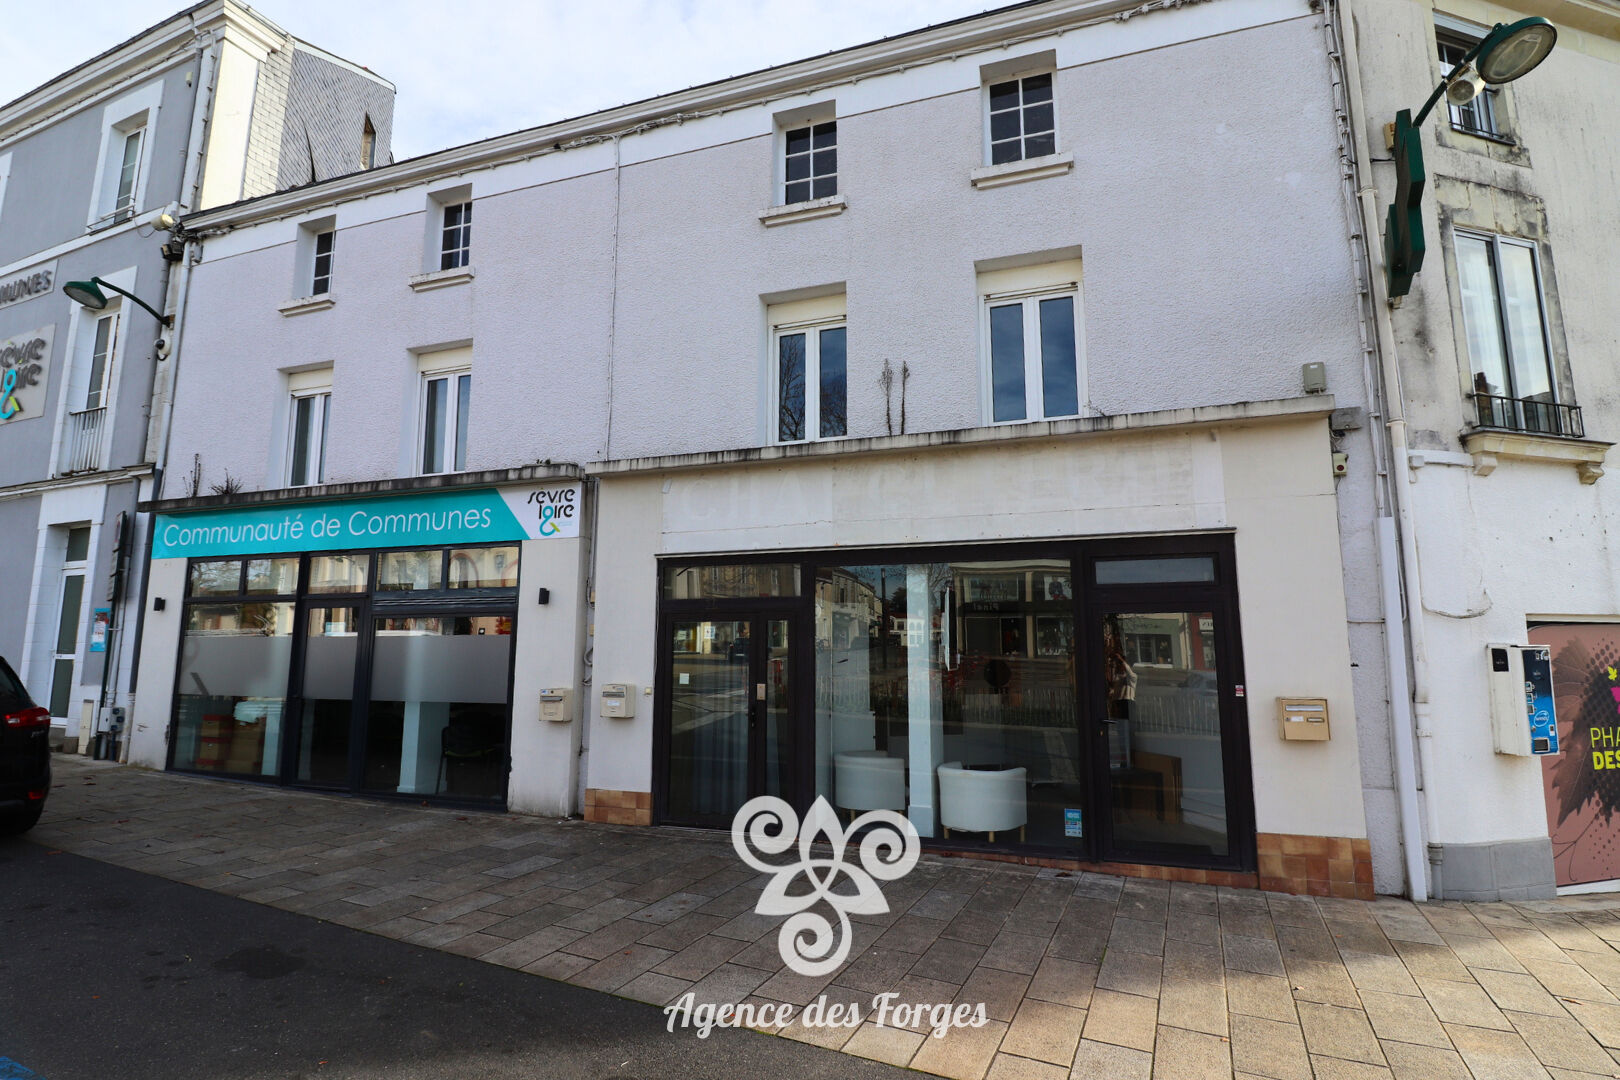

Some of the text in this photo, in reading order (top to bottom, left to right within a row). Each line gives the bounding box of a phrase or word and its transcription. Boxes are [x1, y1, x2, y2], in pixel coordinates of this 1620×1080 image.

[163, 508, 492, 547] Communauté de Communes
